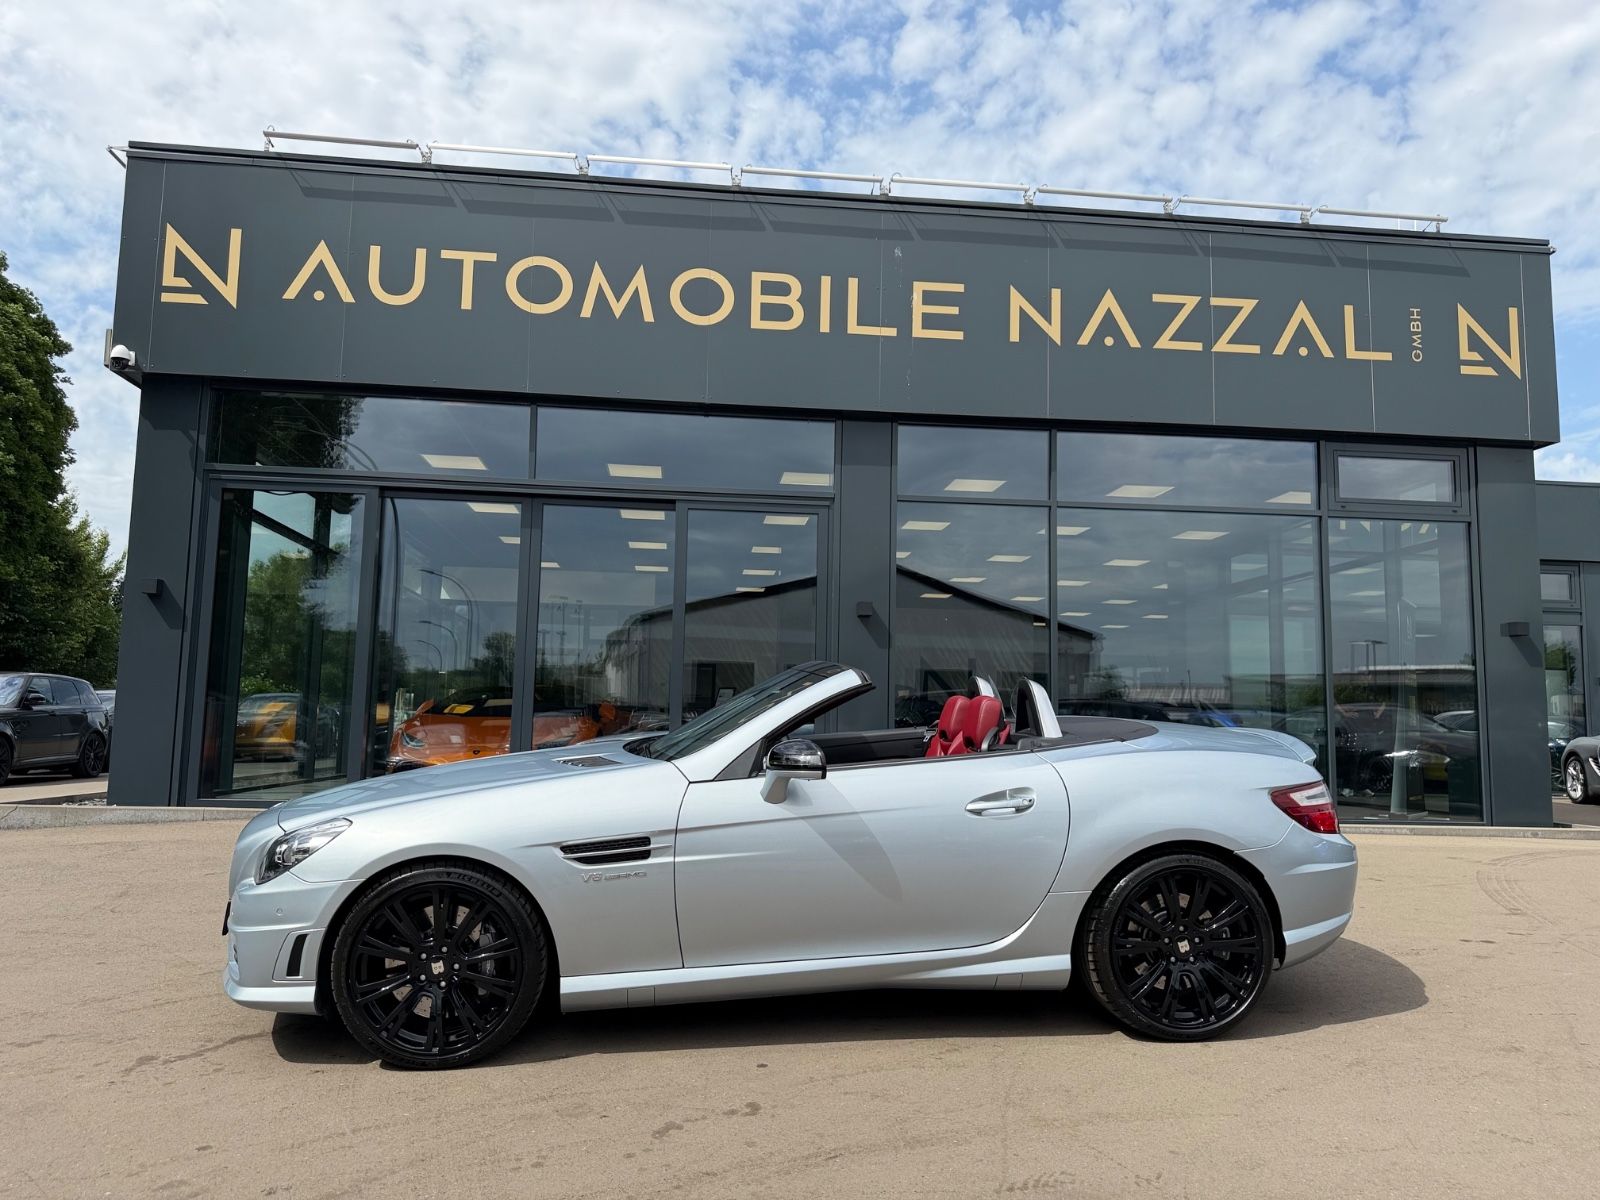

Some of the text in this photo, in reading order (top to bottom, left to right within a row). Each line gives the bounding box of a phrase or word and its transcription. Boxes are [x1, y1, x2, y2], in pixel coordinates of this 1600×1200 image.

[283, 240, 1393, 362] AUTOMOBILE NAZZAL
[1410, 308, 1423, 362] GMBH
